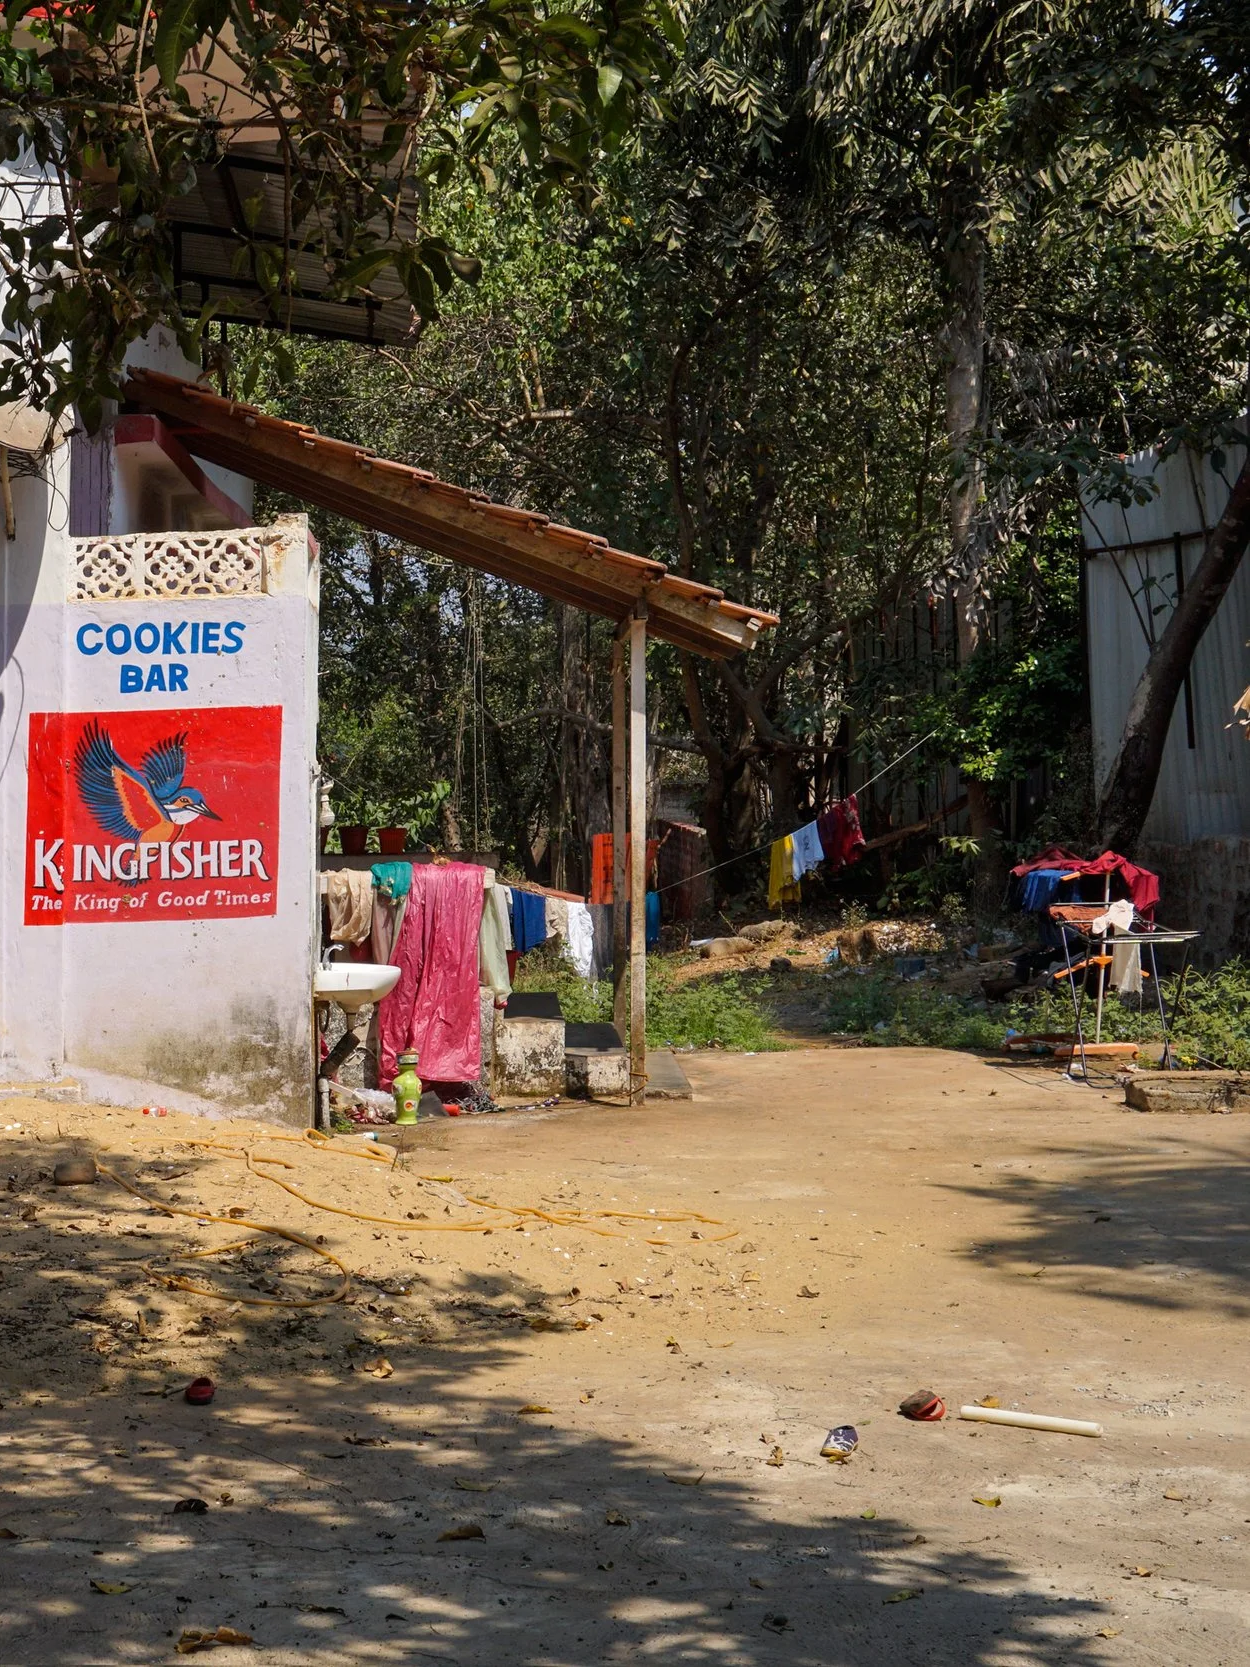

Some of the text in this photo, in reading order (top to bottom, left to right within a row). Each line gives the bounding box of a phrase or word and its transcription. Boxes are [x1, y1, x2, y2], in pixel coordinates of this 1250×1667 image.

[76, 621, 246, 656] COOKIES
[120, 663, 189, 693] BAR
[33, 838, 271, 892] KINGFISHER
[31, 890, 272, 912] The King of Good Times
